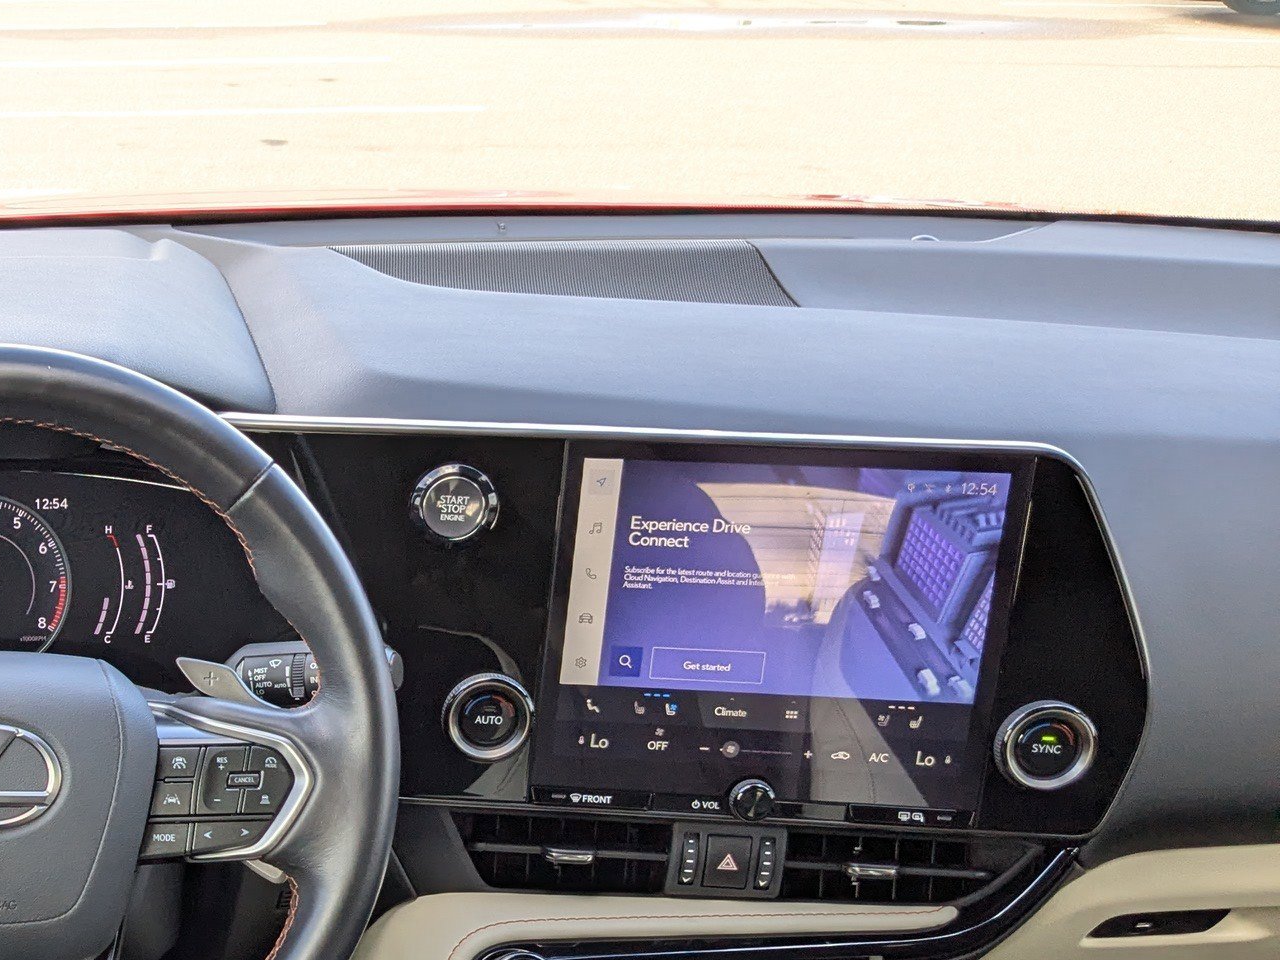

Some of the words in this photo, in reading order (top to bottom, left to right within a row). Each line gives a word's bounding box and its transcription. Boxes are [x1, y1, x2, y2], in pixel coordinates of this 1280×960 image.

[961, 482, 997, 496] 12:54
[35, 498, 68, 510] 12:54
[440, 495, 470, 506] START
[441, 504, 467, 514] STOP
[12, 517, 22, 529] 5
[440, 514, 465, 522] ENGINE
[105, 525, 113, 534] H
[146, 525, 153, 533] F
[630, 515, 710, 534] Experience
[712, 519, 752, 534] Drive
[628, 531, 690, 548] Connect
[38, 542, 48, 554] 6
[624, 565, 655, 574] Subscribe
[655, 566, 665, 574] for
[666, 567, 677, 576] the
[677, 567, 695, 576] latest
[695, 569, 713, 577] route
[726, 570, 751, 578] location
[622, 580, 653, 589] Assistant.
[623, 573, 643, 581] Cloud
[644, 574, 679, 584] Navigation,
[680, 575, 715, 584] Destination
[715, 577, 735, 585] Assist
[49, 580, 58, 592] 7
[37, 617, 47, 629] 8
[104, 635, 111, 644] C
[144, 635, 151, 643] E
[253, 667, 268, 675] MIST
[683, 661, 699, 671] Get
[701, 661, 731, 672] started
[714, 706, 747, 718] Climate
[474, 714, 503, 725] AUTO
[590, 733, 609, 749] Lo
[647, 740, 669, 751] OFF
[1031, 743, 1062, 755] SYNC
[216, 756, 228, 764] RES
[869, 752, 890, 764] A/C
[915, 751, 936, 766] Lo
[582, 794, 613, 804] FRONT
[702, 801, 720, 810] VOL
[153, 833, 176, 842] MODE
